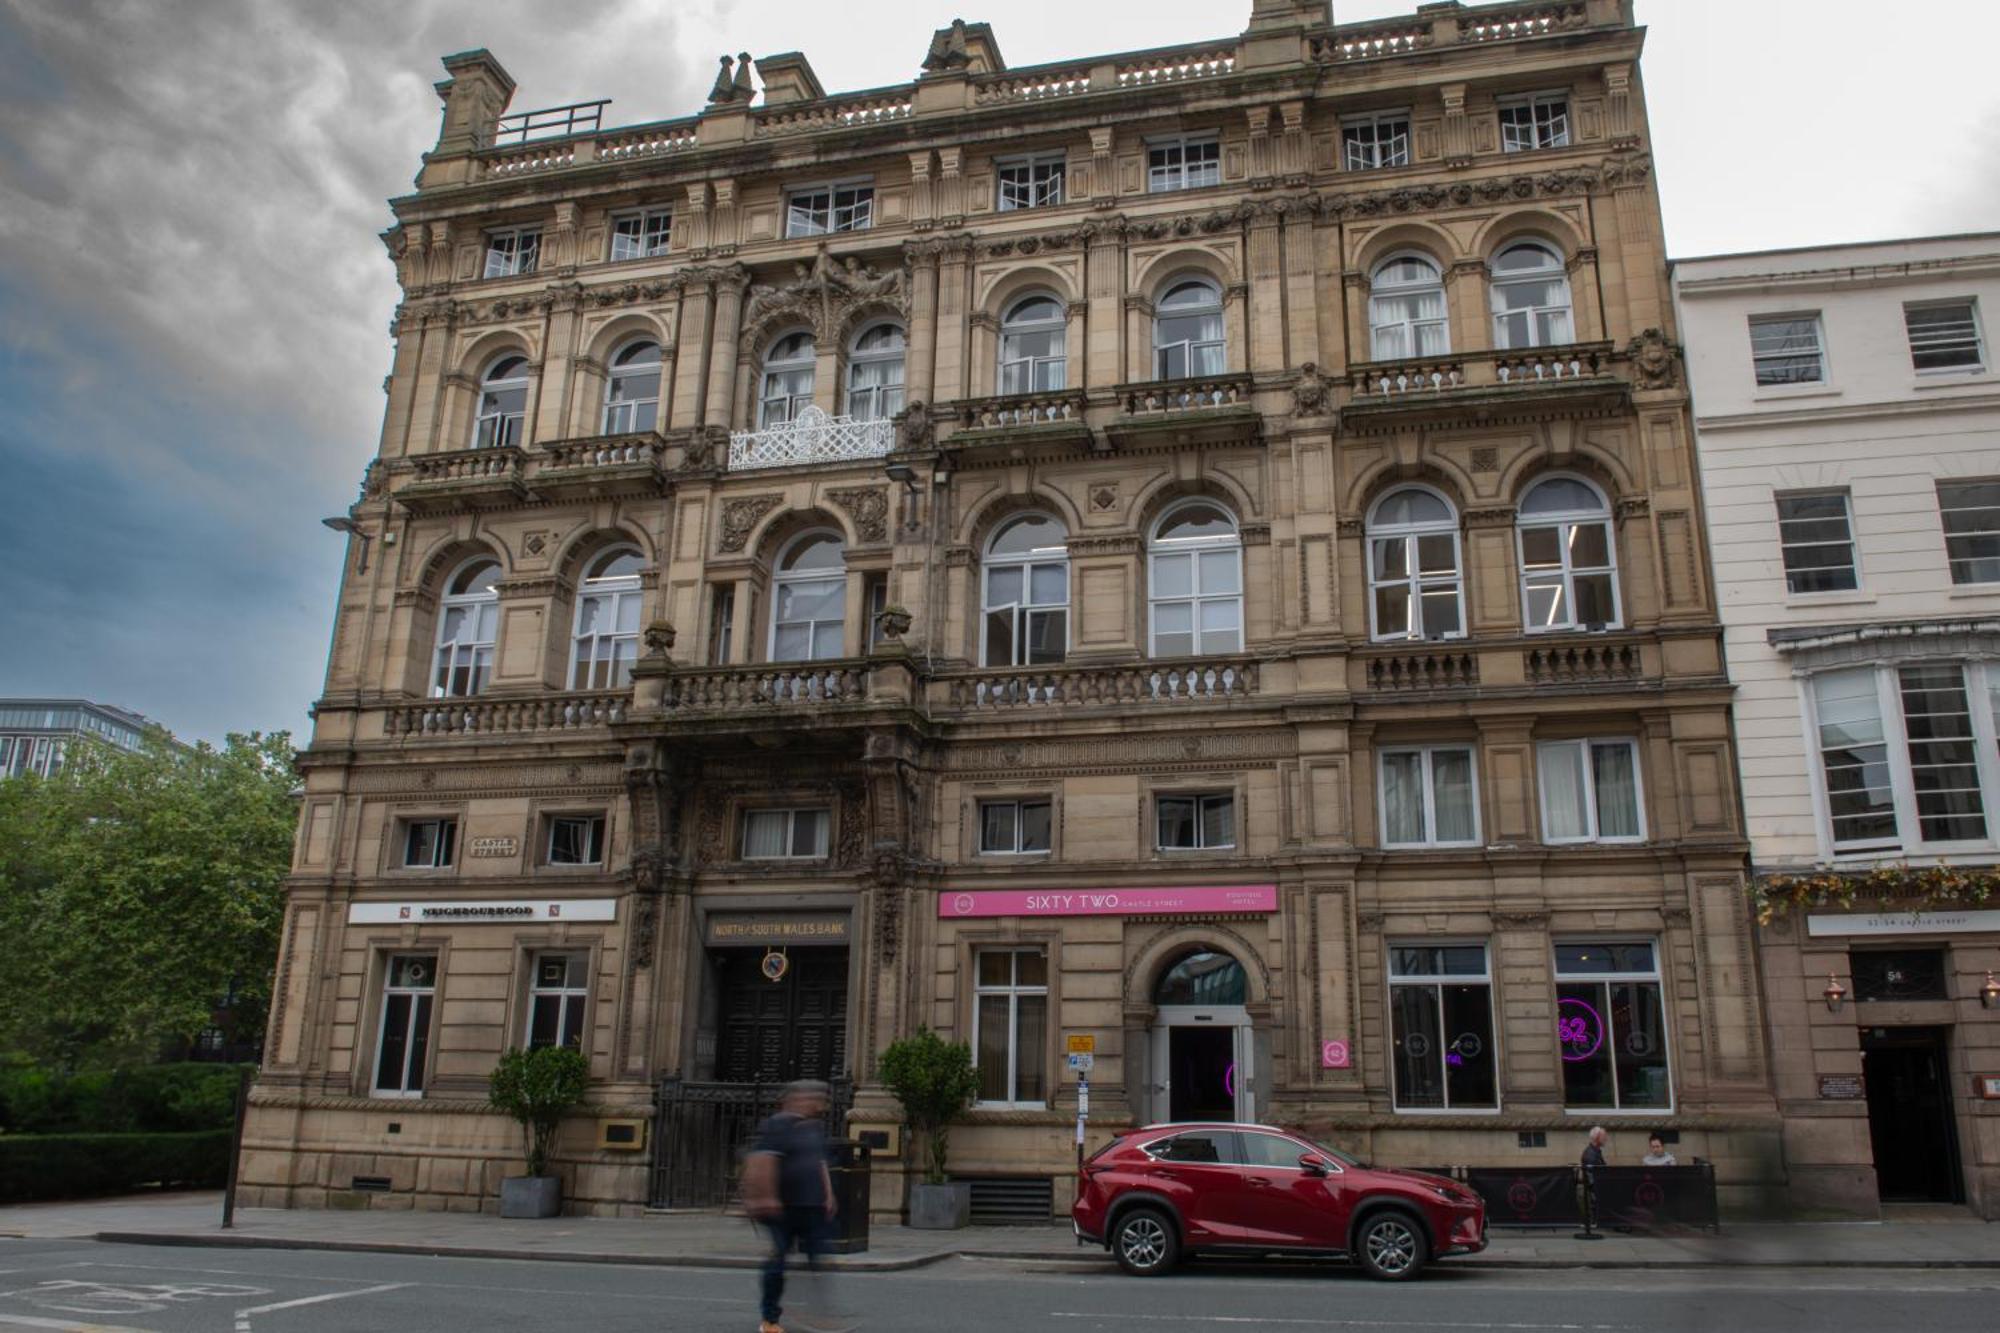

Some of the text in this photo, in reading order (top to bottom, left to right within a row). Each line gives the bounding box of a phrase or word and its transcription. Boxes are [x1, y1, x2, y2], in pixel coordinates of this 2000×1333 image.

[474, 839, 513, 848] CASTLE
[474, 847, 513, 857] STREET
[1026, 896, 1073, 909] SIXTY
[1079, 894, 1119, 908] TWO
[422, 906, 534, 917] NEIGHBOURHOOD
[715, 924, 744, 936] NORTH
[751, 923, 781, 935] SOUTH
[783, 922, 815, 935] WALES
[817, 920, 845, 935] BANK
